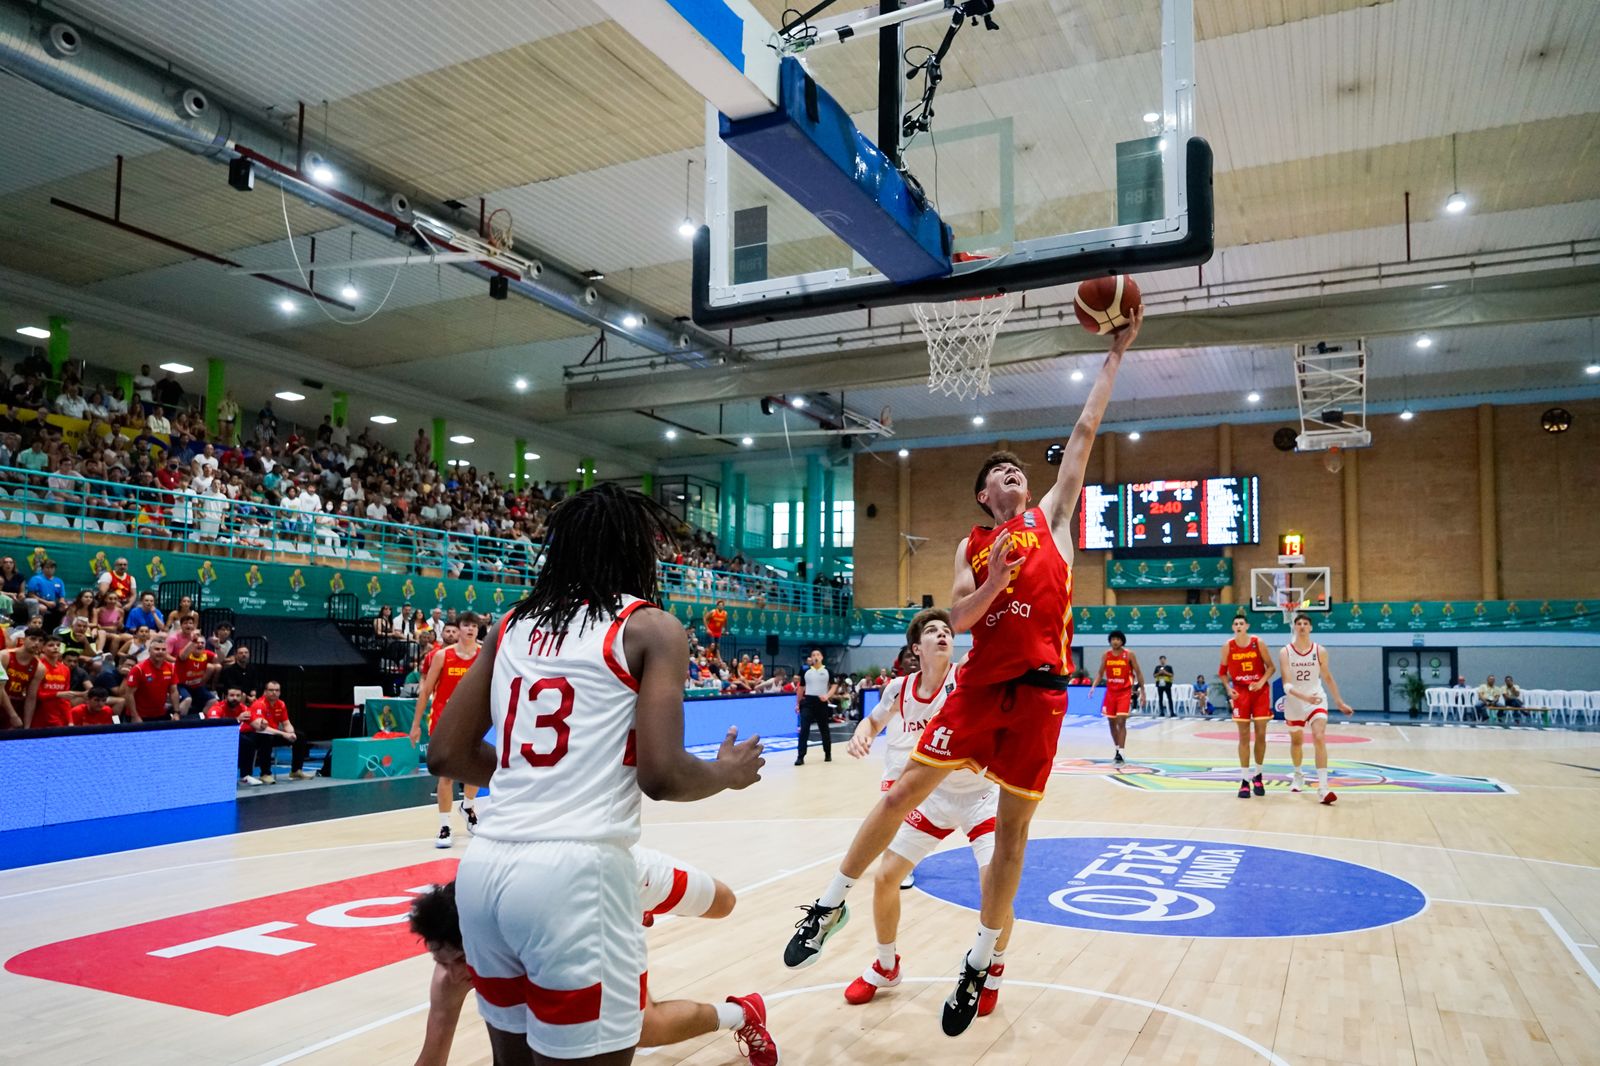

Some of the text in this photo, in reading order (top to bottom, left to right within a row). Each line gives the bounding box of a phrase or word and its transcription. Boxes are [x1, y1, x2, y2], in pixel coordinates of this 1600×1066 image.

[1140, 490, 1158, 502] 14
[1174, 488, 1192, 500] 12
[1150, 501, 1182, 514] 2:40
[1162, 522, 1170, 534] 1
[1188, 522, 1198, 533] 2
[1241, 662, 1253, 672] 15
[1296, 671, 1311, 681] 22
[501, 677, 575, 768] 13
[931, 726, 954, 749] fi
[924, 744, 952, 756] network
[1174, 850, 1246, 888] WANDA
